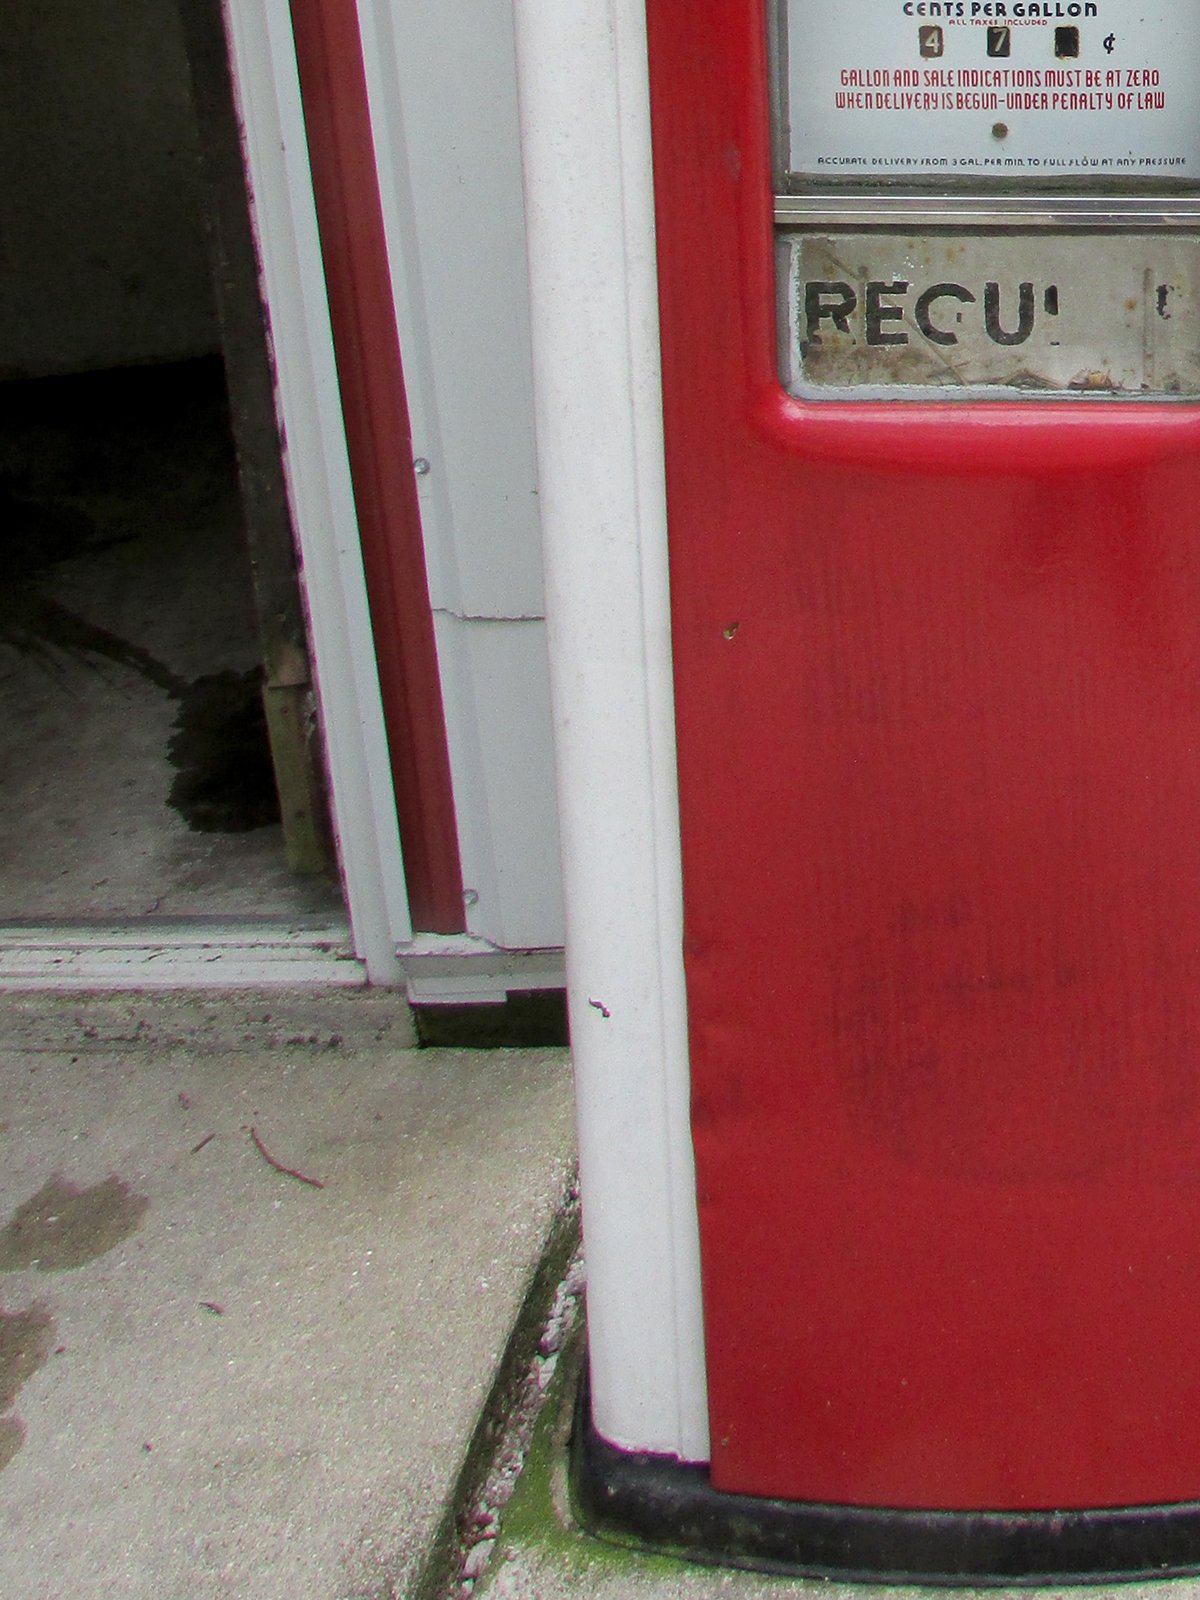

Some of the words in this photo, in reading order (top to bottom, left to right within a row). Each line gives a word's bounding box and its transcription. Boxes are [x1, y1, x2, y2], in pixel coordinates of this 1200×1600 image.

[903, 2, 964, 17] CENTS
[971, 2, 1007, 17] PER
[1013, 2, 1098, 17] GALLON
[841, 69, 890, 87] GALLON
[893, 70, 919, 87] AND
[924, 70, 954, 87] SALE
[958, 70, 1041, 87] INDICATIONS
[1045, 70, 1081, 87] MUST
[1085, 70, 1102, 87] BE
[1105, 70, 1122, 87] AT
[1126, 70, 1159, 87] ZERO
[836, 92, 873, 110] WHEN
[876, 92, 938, 110] DELIVERY
[942, 93, 954, 110] IS
[1052, 93, 1113, 110] PENALTY
[1118, 92, 1134, 110] OF
[1138, 91, 1165, 110] LAW
[818, 157, 867, 165] ACCURATE
[872, 158, 918, 166] DELIVERY
[921, 158, 948, 166] FROM
[984, 158, 1001, 166] PER
[1027, 158, 1040, 166] TO
[1043, 158, 1066, 166] FULL
[1101, 158, 1113, 166] AT
[1116, 158, 1136, 166] ANY
[1139, 157, 1186, 166] PRESSURE
